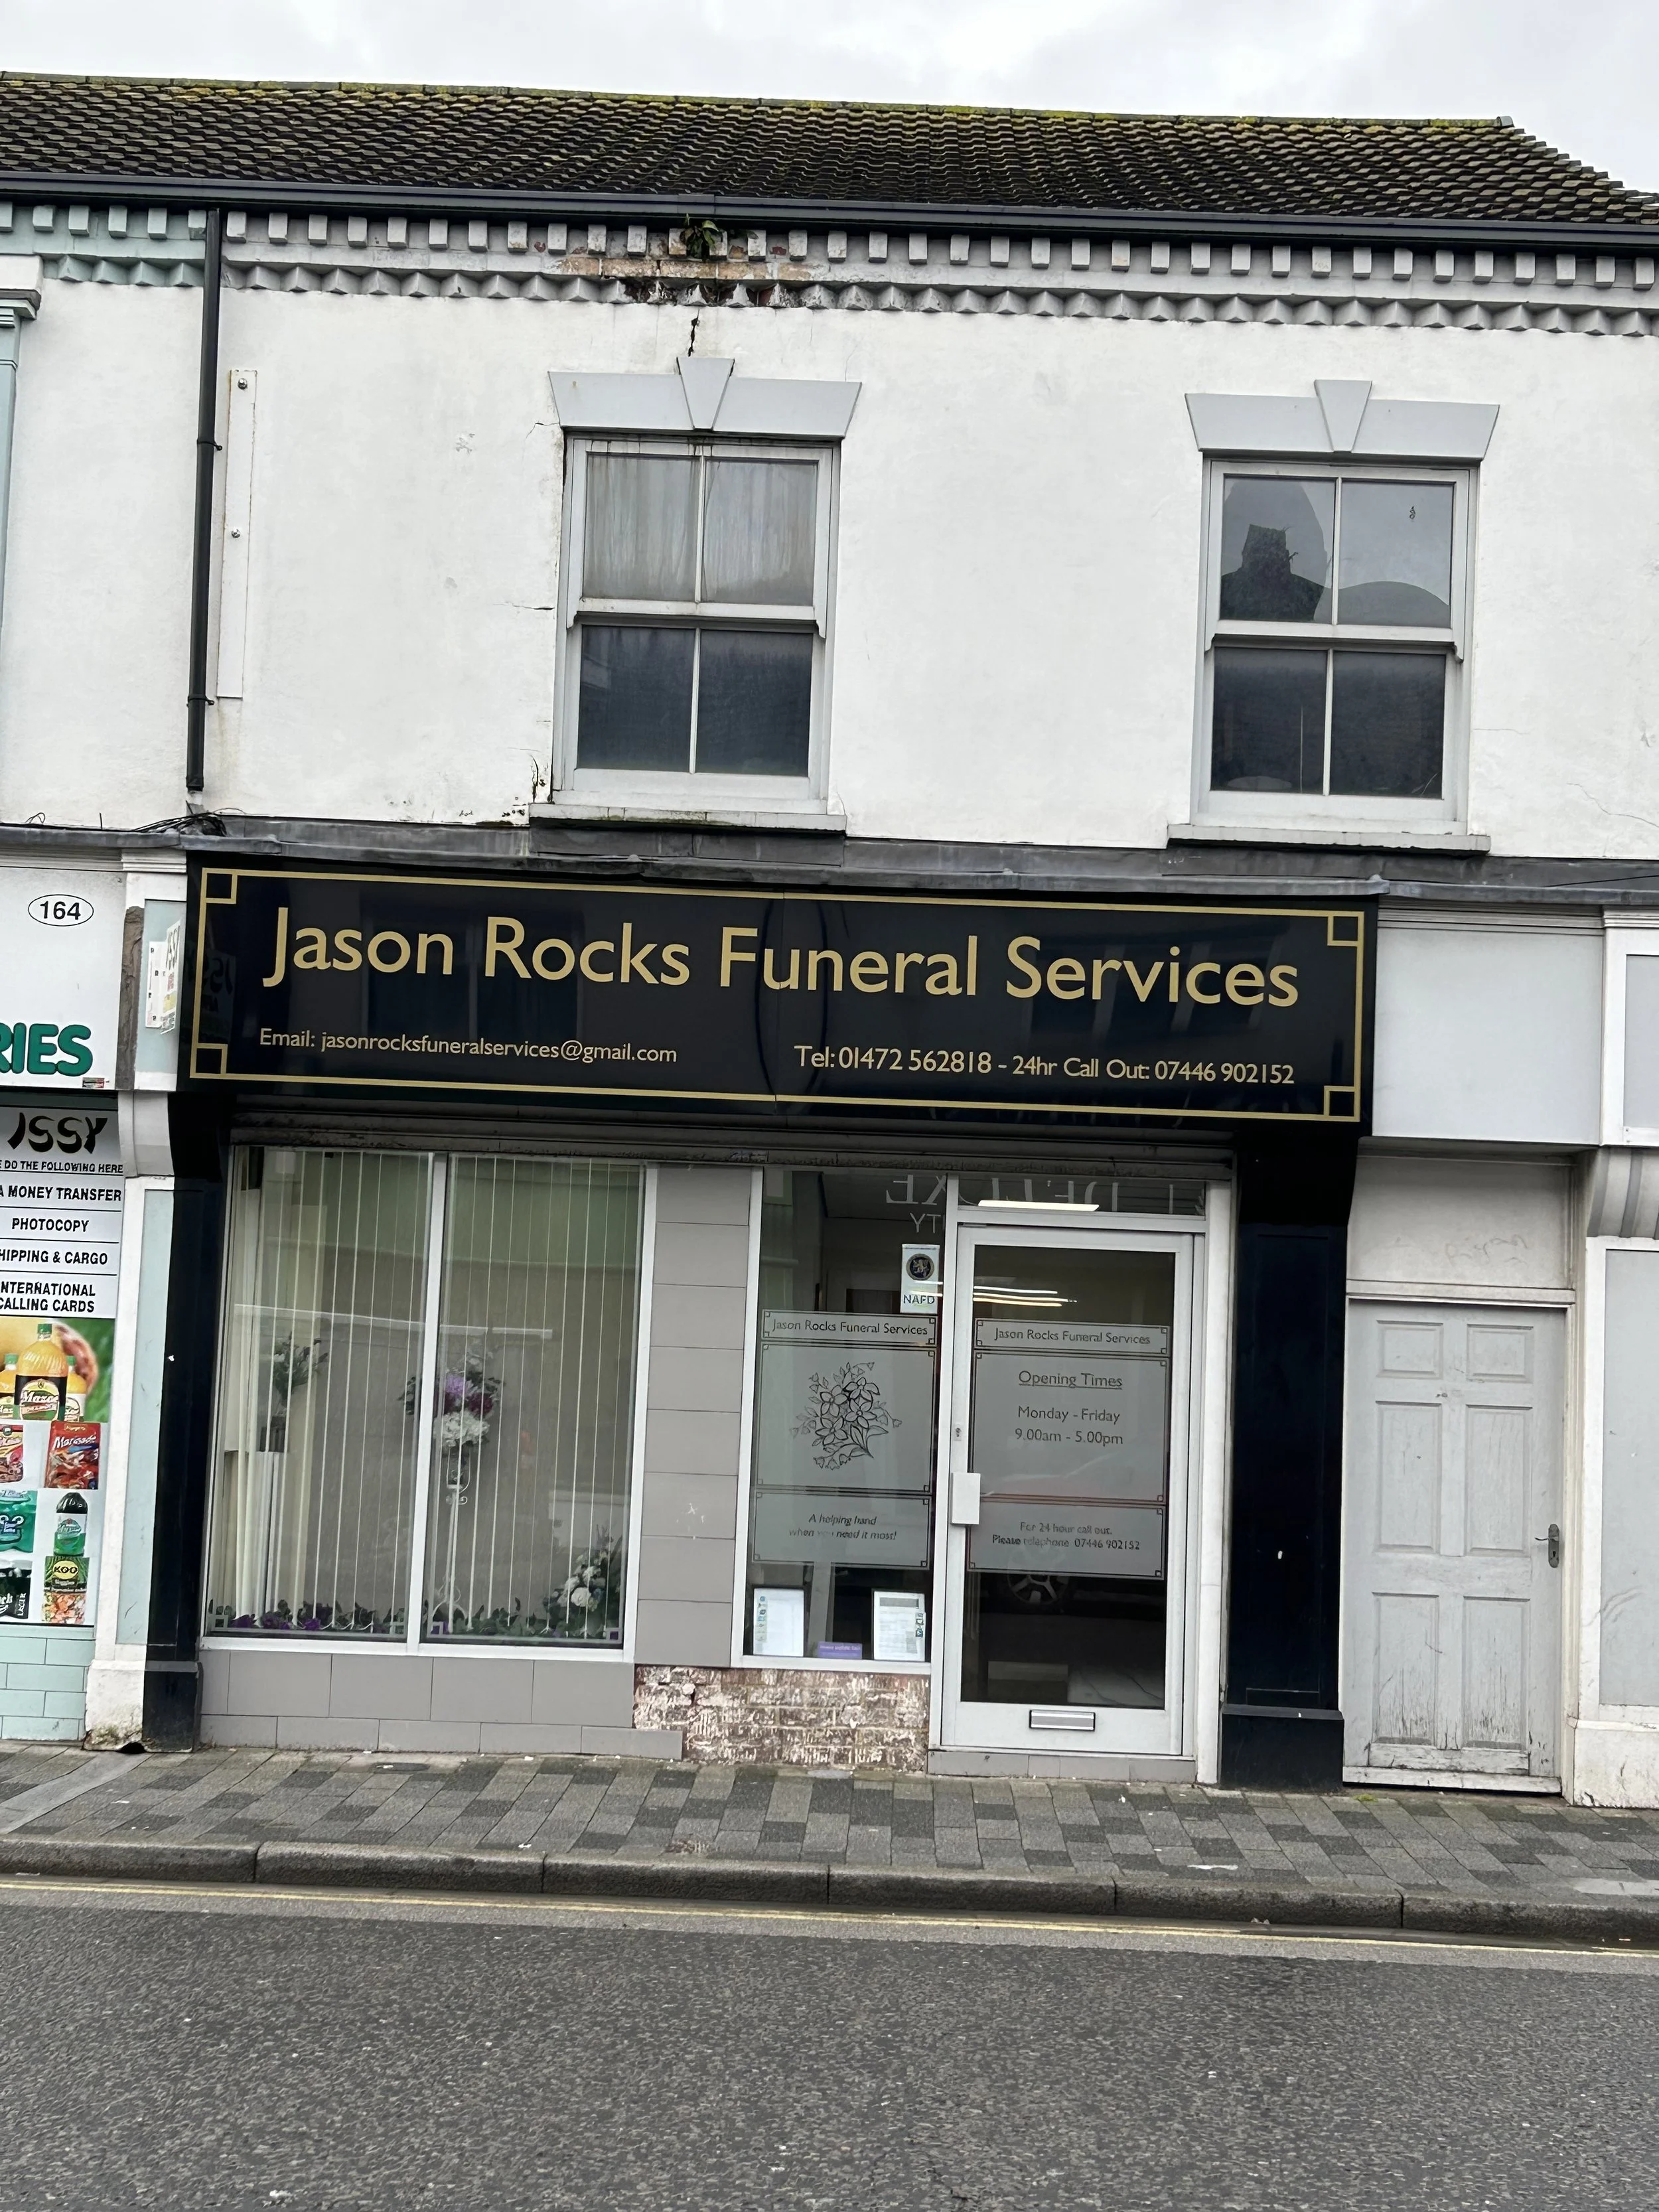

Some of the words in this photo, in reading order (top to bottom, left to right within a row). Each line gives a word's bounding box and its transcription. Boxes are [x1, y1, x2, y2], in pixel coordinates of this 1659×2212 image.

[40, 901, 82, 921] 164
[263, 907, 453, 988] Jason
[485, 917, 689, 986] Rocks
[721, 927, 977, 995] Funeral
[1007, 936, 1298, 1007] Services
[259, 1028, 315, 1047] Email:
[321, 1031, 677, 1063] jasonrocksfuneralservices@gmail.com
[908, 1049, 991, 1074] 562818
[1013, 1055, 1058, 1076] 24hr
[1063, 1057, 1099, 1077] Call
[1106, 1059, 1150, 1079] Out:
[1155, 1061, 1216, 1082] 07446
[1222, 1063, 1295, 1084] 902152
[5, 1159, 18, 1169] DO
[20, 1161, 38, 1171] THE
[41, 1161, 96, 1172] FOLLOWING
[98, 1163, 124, 1173] HERE
[8, 1185, 53, 1199] MONEY
[56, 1187, 122, 1201] TRANSFER
[11, 1217, 90, 1232] PHOTOCOPY
[52, 1251, 61, 1264] &
[64, 1252, 108, 1266] CARGO
[52, 1299, 95, 1313] CARDS
[903, 1294, 935, 1304] NAFD
[772, 1319, 801, 1332] Jason
[804, 1319, 836, 1332] Rocks
[840, 1321, 880, 1333] Funeral
[883, 1323, 928, 1335] Services
[995, 1327, 1023, 1341] Jason
[1027, 1329, 1059, 1341] Rocks
[1062, 1331, 1102, 1343] Funeral
[1106, 1333, 1151, 1345] Services
[1019, 1370, 1077, 1388] Opening
[1080, 1372, 1123, 1387] Times
[1018, 1406, 1069, 1423] Monday
[1081, 1408, 1121, 1425] Friday
[1015, 1428, 1062, 1442] 9.00am
[1074, 1430, 1123, 1447] 5.00pm
[808, 1513, 816, 1523] A
[854, 1515, 877, 1526] hand
[1020, 1521, 1037, 1532] For
[1039, 1522, 1050, 1532] 24
[1052, 1523, 1075, 1534] hour
[1077, 1525, 1092, 1535] call
[992, 1534, 1021, 1545] Please
[1074, 1538, 1104, 1549] 07446
[1106, 1539, 1141, 1550] 902152
